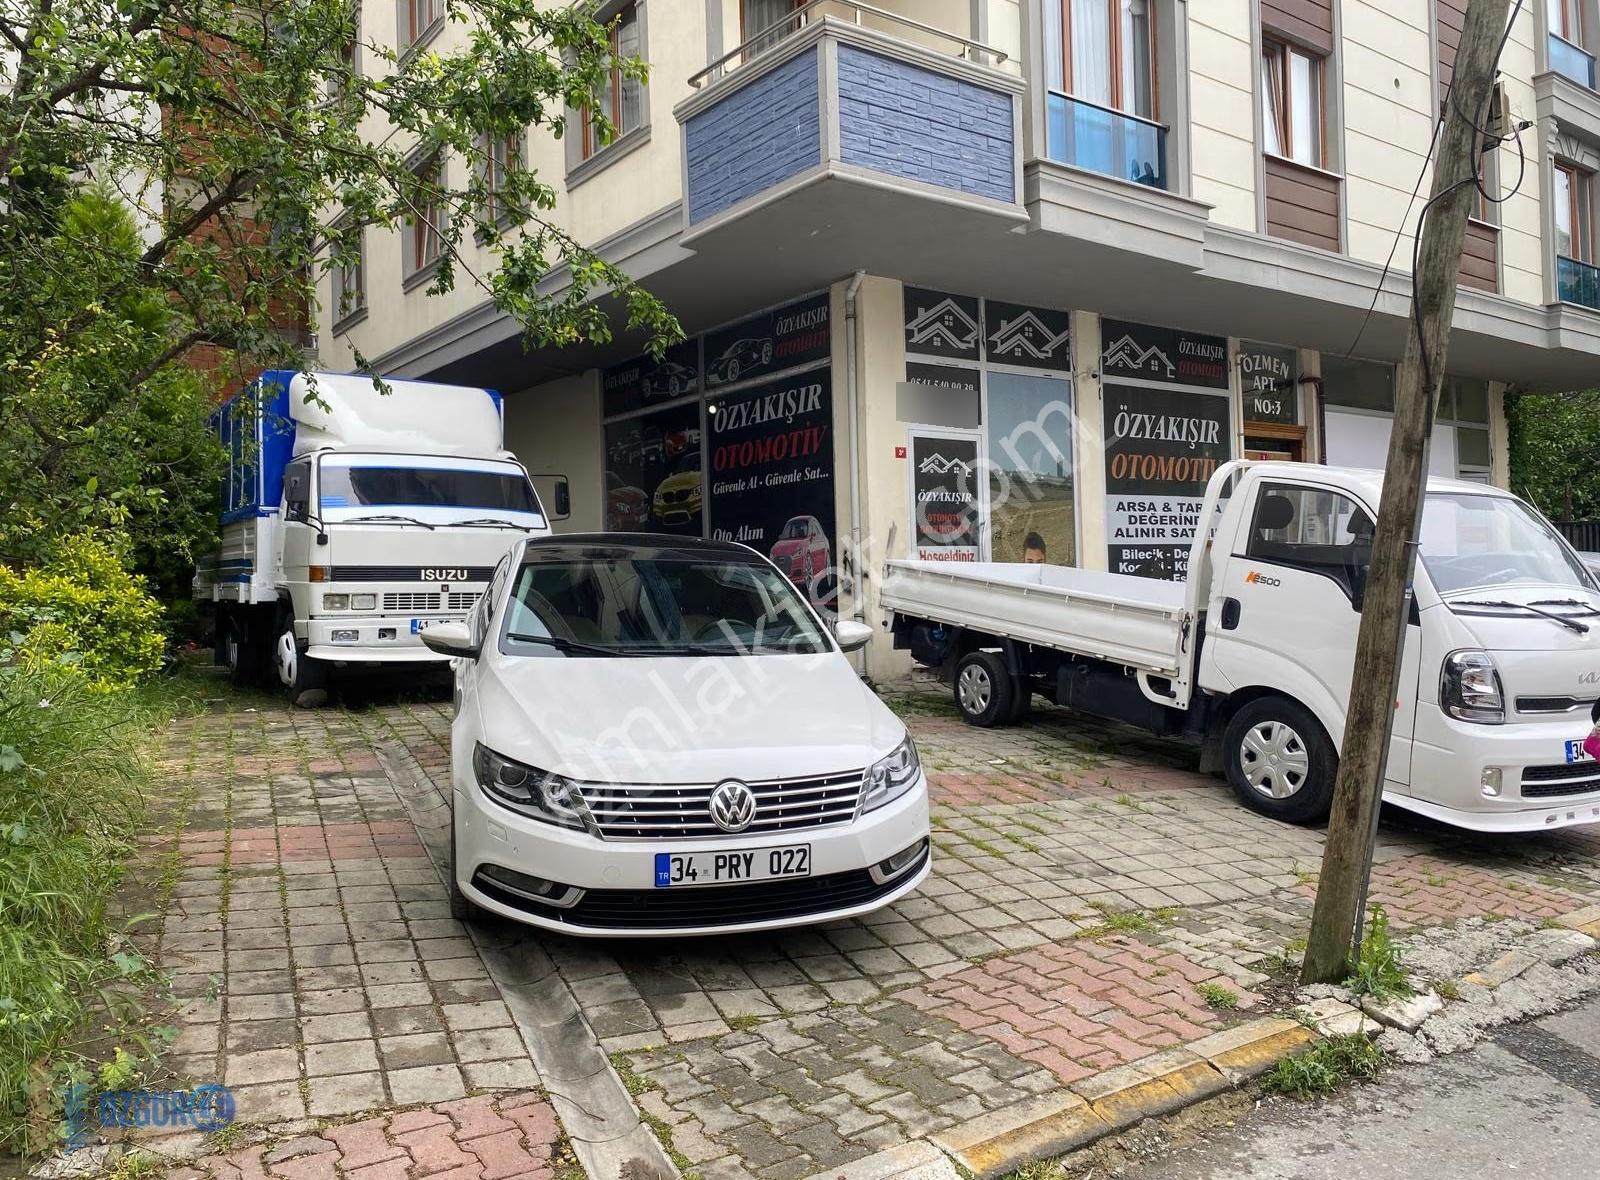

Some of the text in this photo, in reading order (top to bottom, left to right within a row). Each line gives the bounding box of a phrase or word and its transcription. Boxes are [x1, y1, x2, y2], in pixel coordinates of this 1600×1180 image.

[776, 305, 828, 337] ÖZYAKIŞIR
[1179, 337, 1224, 361] ÖZYAKIŞIR
[1242, 353, 1289, 380] ÖZMEN
[1253, 375, 1277, 392] APT.
[713, 383, 823, 433] ÖZYAKIŞIR
[1254, 398, 1282, 415] NO:3
[1114, 404, 1220, 449] ÖZYAKIŞIR
[713, 422, 829, 472] OTOMOTİV
[713, 480, 746, 495] Güvenle
[747, 478, 758, 491] Al
[765, 469, 802, 487] Güvenle
[803, 466, 829, 481] Sat...
[918, 488, 973, 505] ÖZYAKIŞIR
[1115, 501, 1158, 513] ARSA
[1162, 502, 1172, 513] &
[1128, 513, 1200, 526] DEĞERİN
[713, 524, 764, 543] Oto Alım
[1114, 527, 1166, 538] ALINIR
[420, 568, 468, 581] ISUZU
[1246, 571, 1281, 587] K2500
[1573, 743, 1585, 760] 34
[658, 848, 808, 882] TR 34 PRY 022
